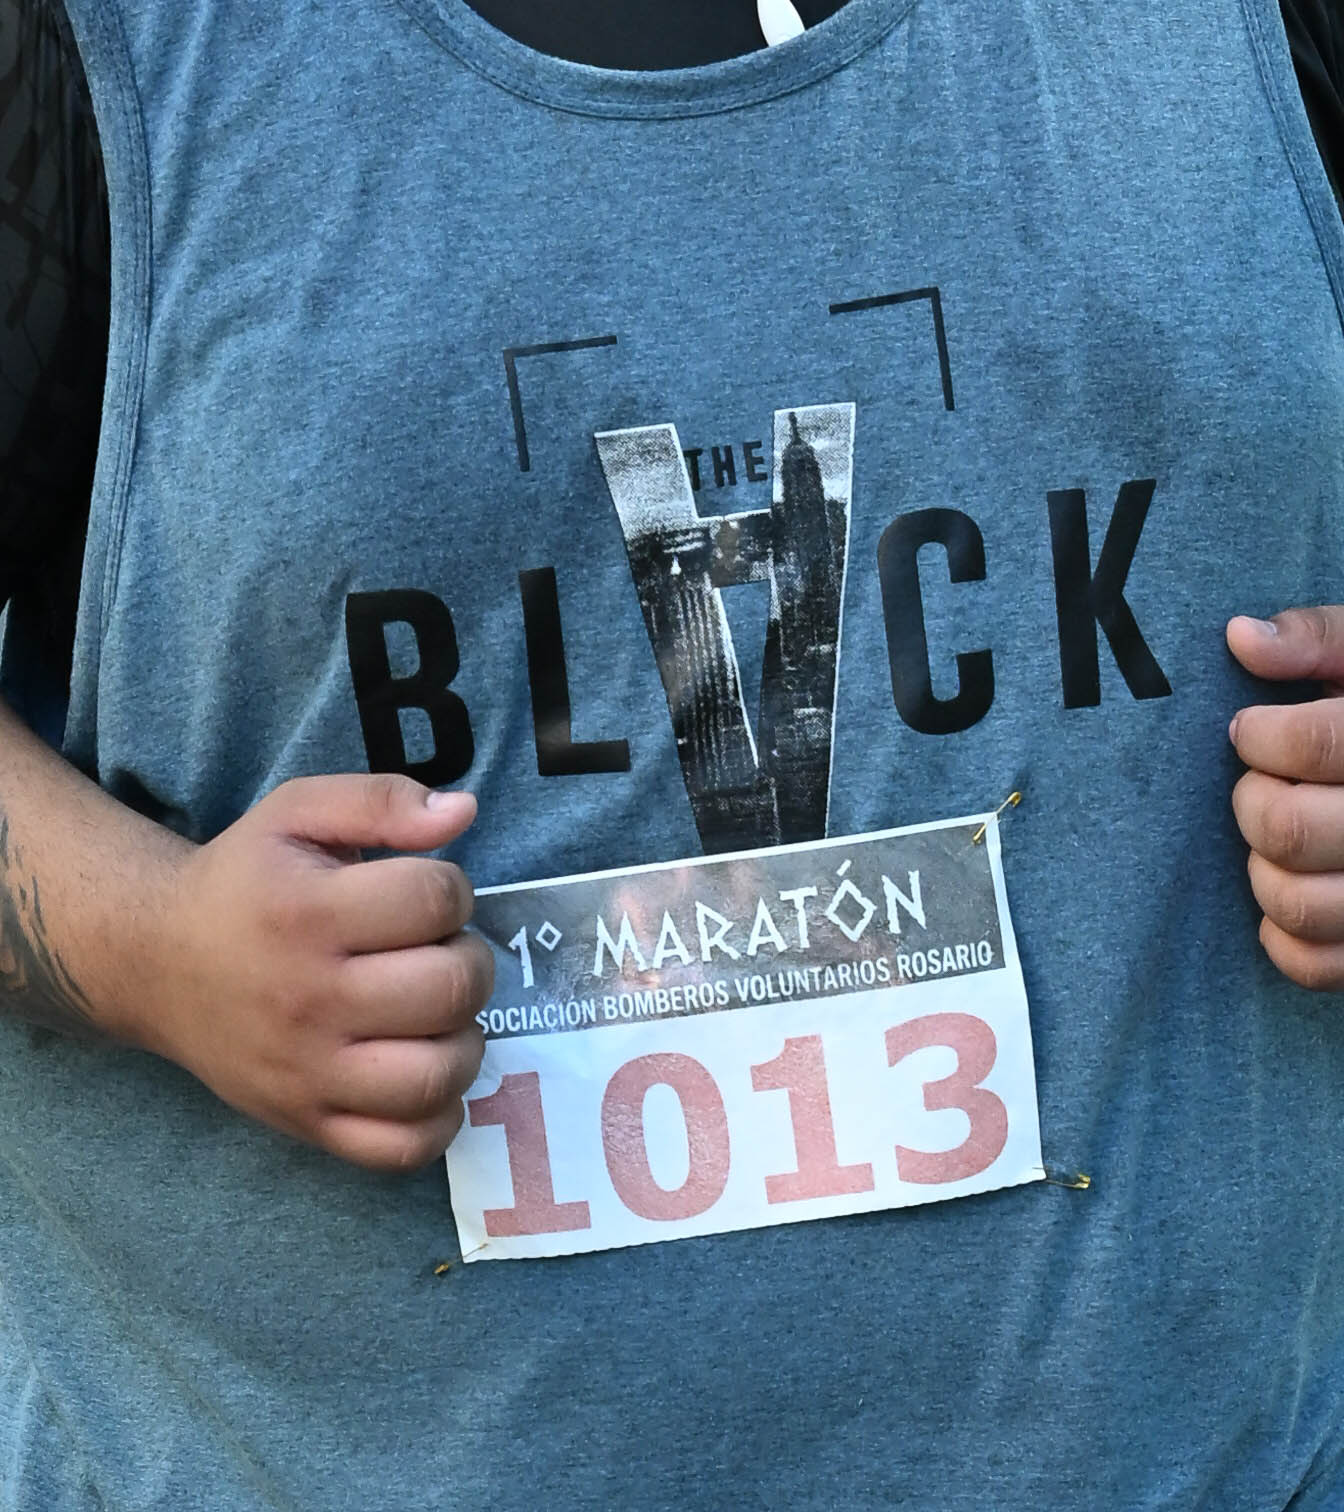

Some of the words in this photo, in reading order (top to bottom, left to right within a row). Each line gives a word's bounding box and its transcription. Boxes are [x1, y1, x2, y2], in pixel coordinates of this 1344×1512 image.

[682, 439, 769, 491] THE
[345, 401, 1173, 849] BLACK
[593, 859, 927, 977] MARATÓN
[474, 994, 597, 1035] SOCIACIÓN
[604, 980, 730, 1021] BOMBEROS
[734, 957, 891, 1002] VOLUNTARIOS
[897, 939, 994, 979] ROSARIO
[467, 1011, 1009, 1238] 1013
